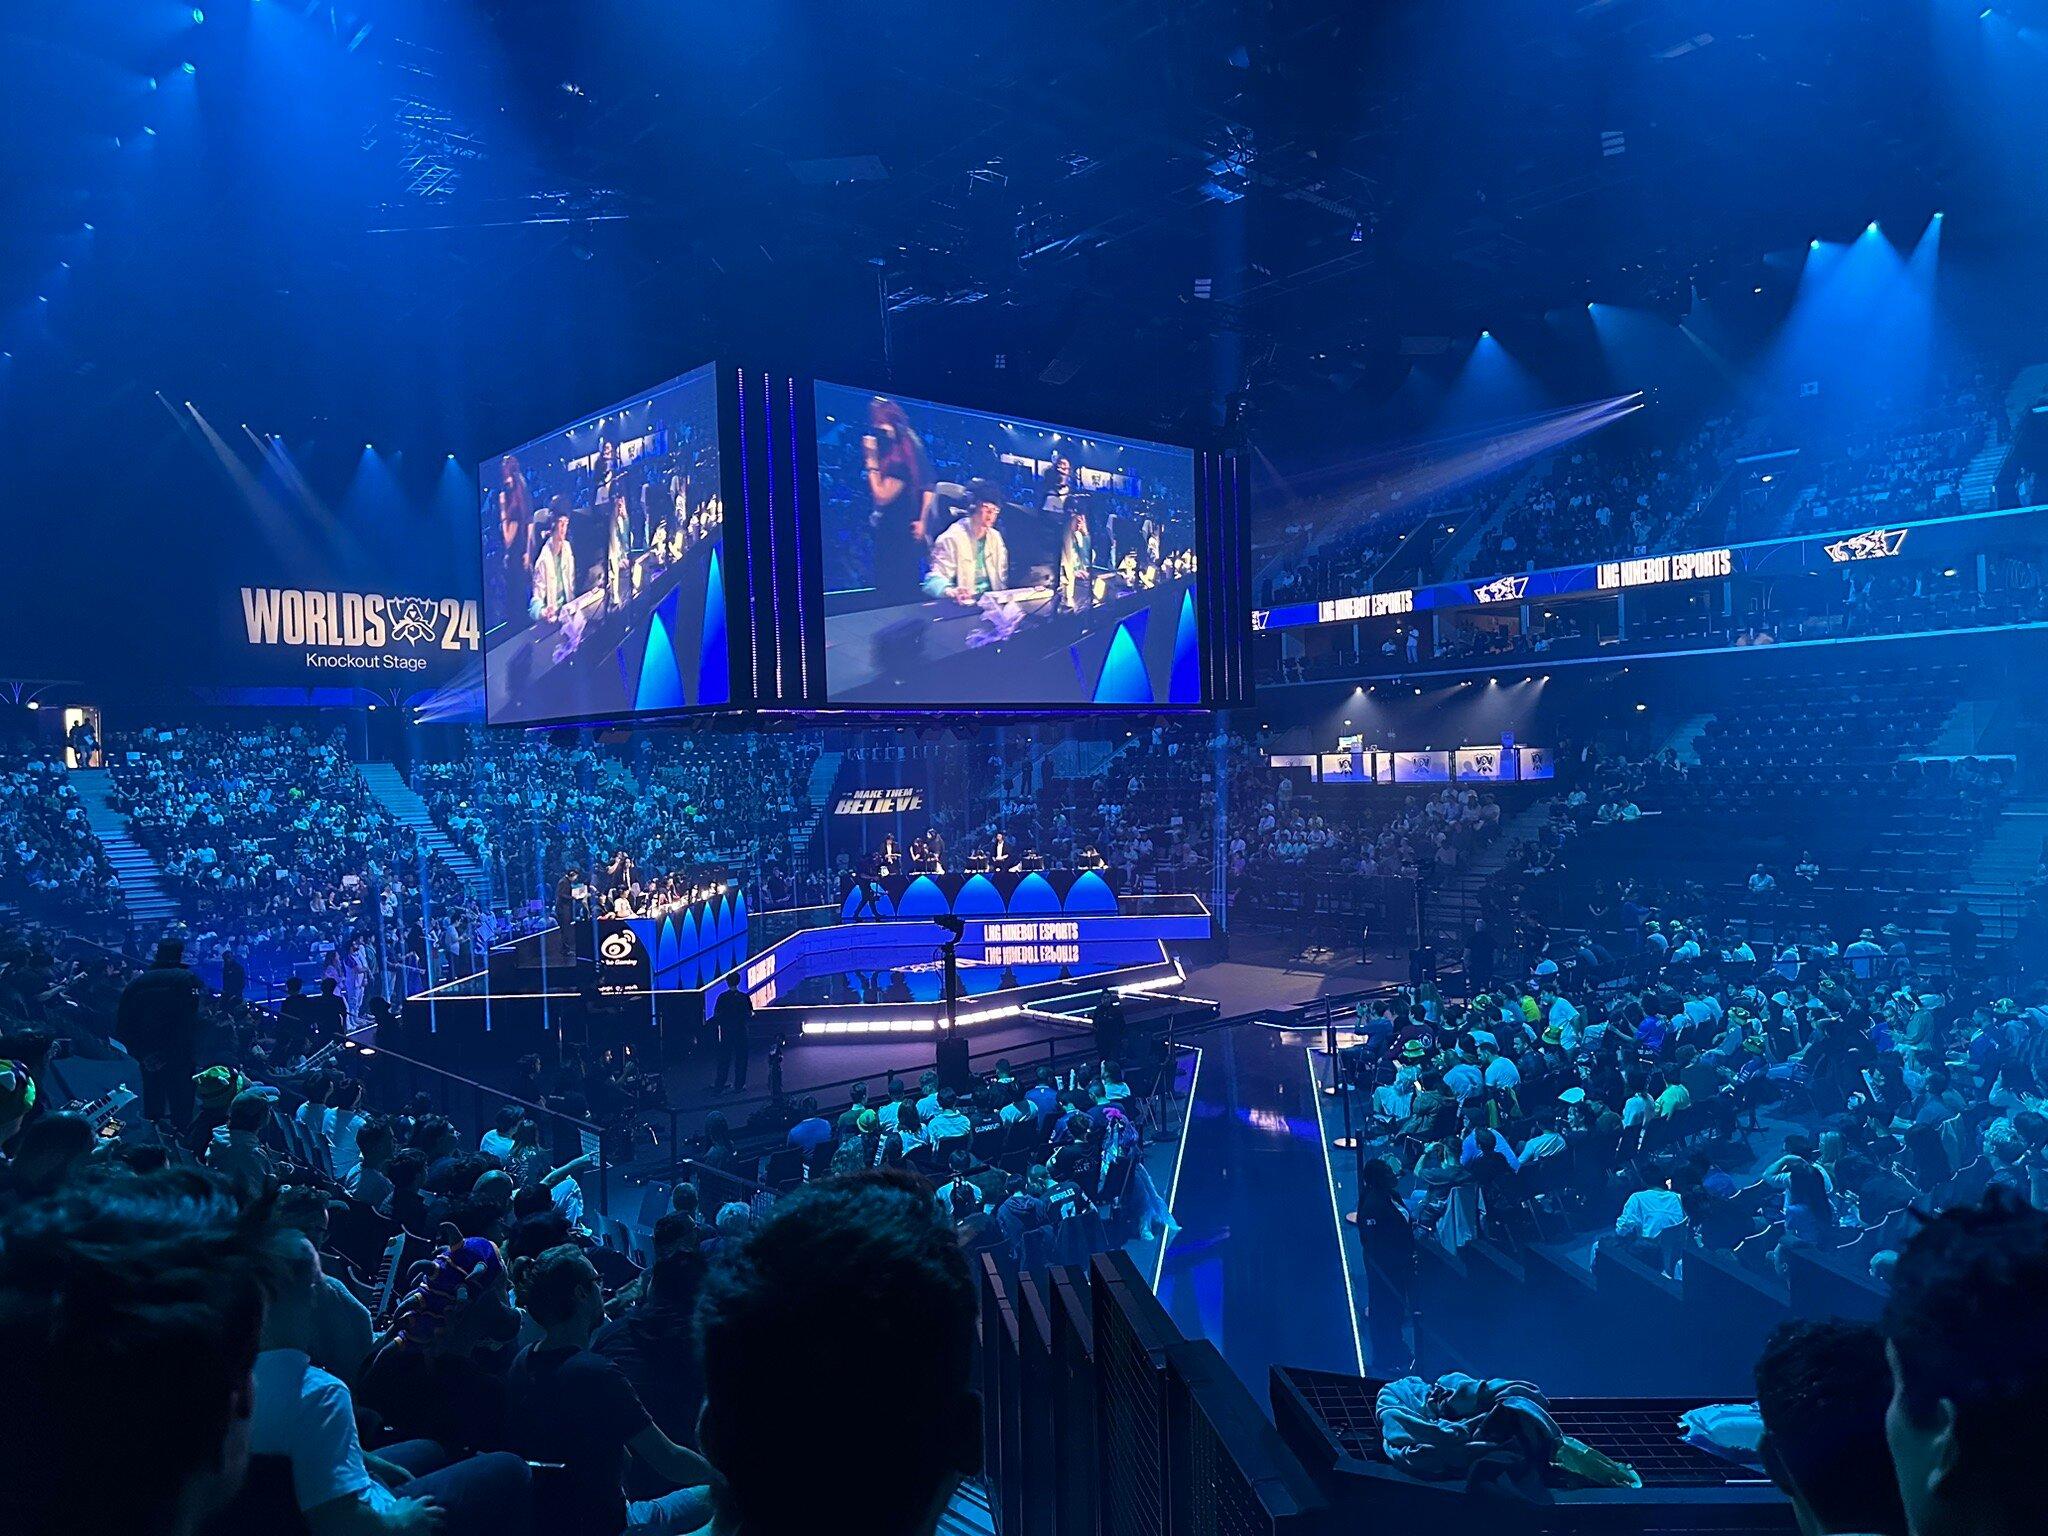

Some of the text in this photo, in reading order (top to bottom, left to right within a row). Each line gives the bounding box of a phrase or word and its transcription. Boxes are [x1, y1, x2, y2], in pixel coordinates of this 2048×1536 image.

[1597, 549, 1731, 589] LNG NINEBOT ESPORTS
[1371, 590, 1413, 616] ESPORTS
[241, 587, 480, 650] WORLDS 24
[306, 653, 427, 672] Knockout Stage
[853, 787, 913, 799] MAKE THEM
[834, 796, 922, 815] BELIEVE
[1001, 923, 1038, 941] NINEBOT
[1039, 922, 1079, 940] ESPORTS
